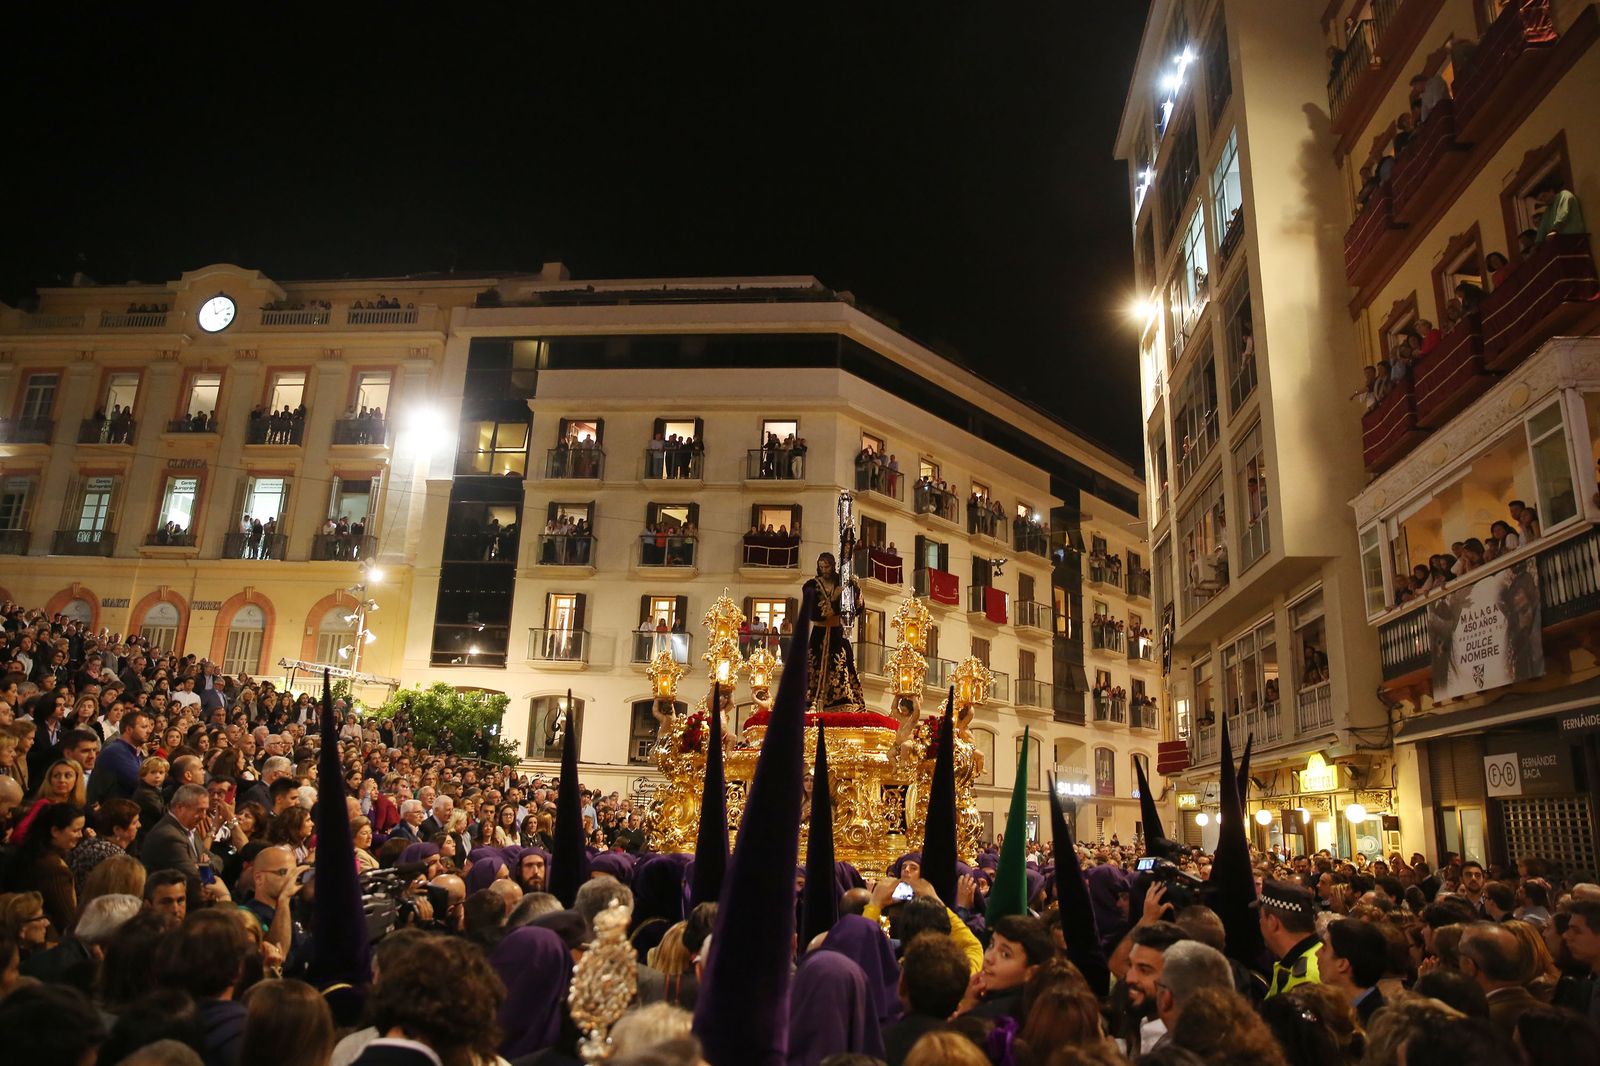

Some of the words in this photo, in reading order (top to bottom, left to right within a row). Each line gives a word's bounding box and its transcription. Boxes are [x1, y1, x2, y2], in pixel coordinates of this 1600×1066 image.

[1460, 604, 1499, 623] MÁLAGA
[1463, 622, 1478, 633] 450
[1479, 615, 1498, 629] AÑOS
[1466, 636, 1493, 652] DULCE
[1460, 645, 1500, 664] NOMBRE
[1521, 754, 1557, 767] FERNÁNDEZ
[1523, 768, 1541, 779] BACA
[1057, 782, 1091, 796] SILBON
